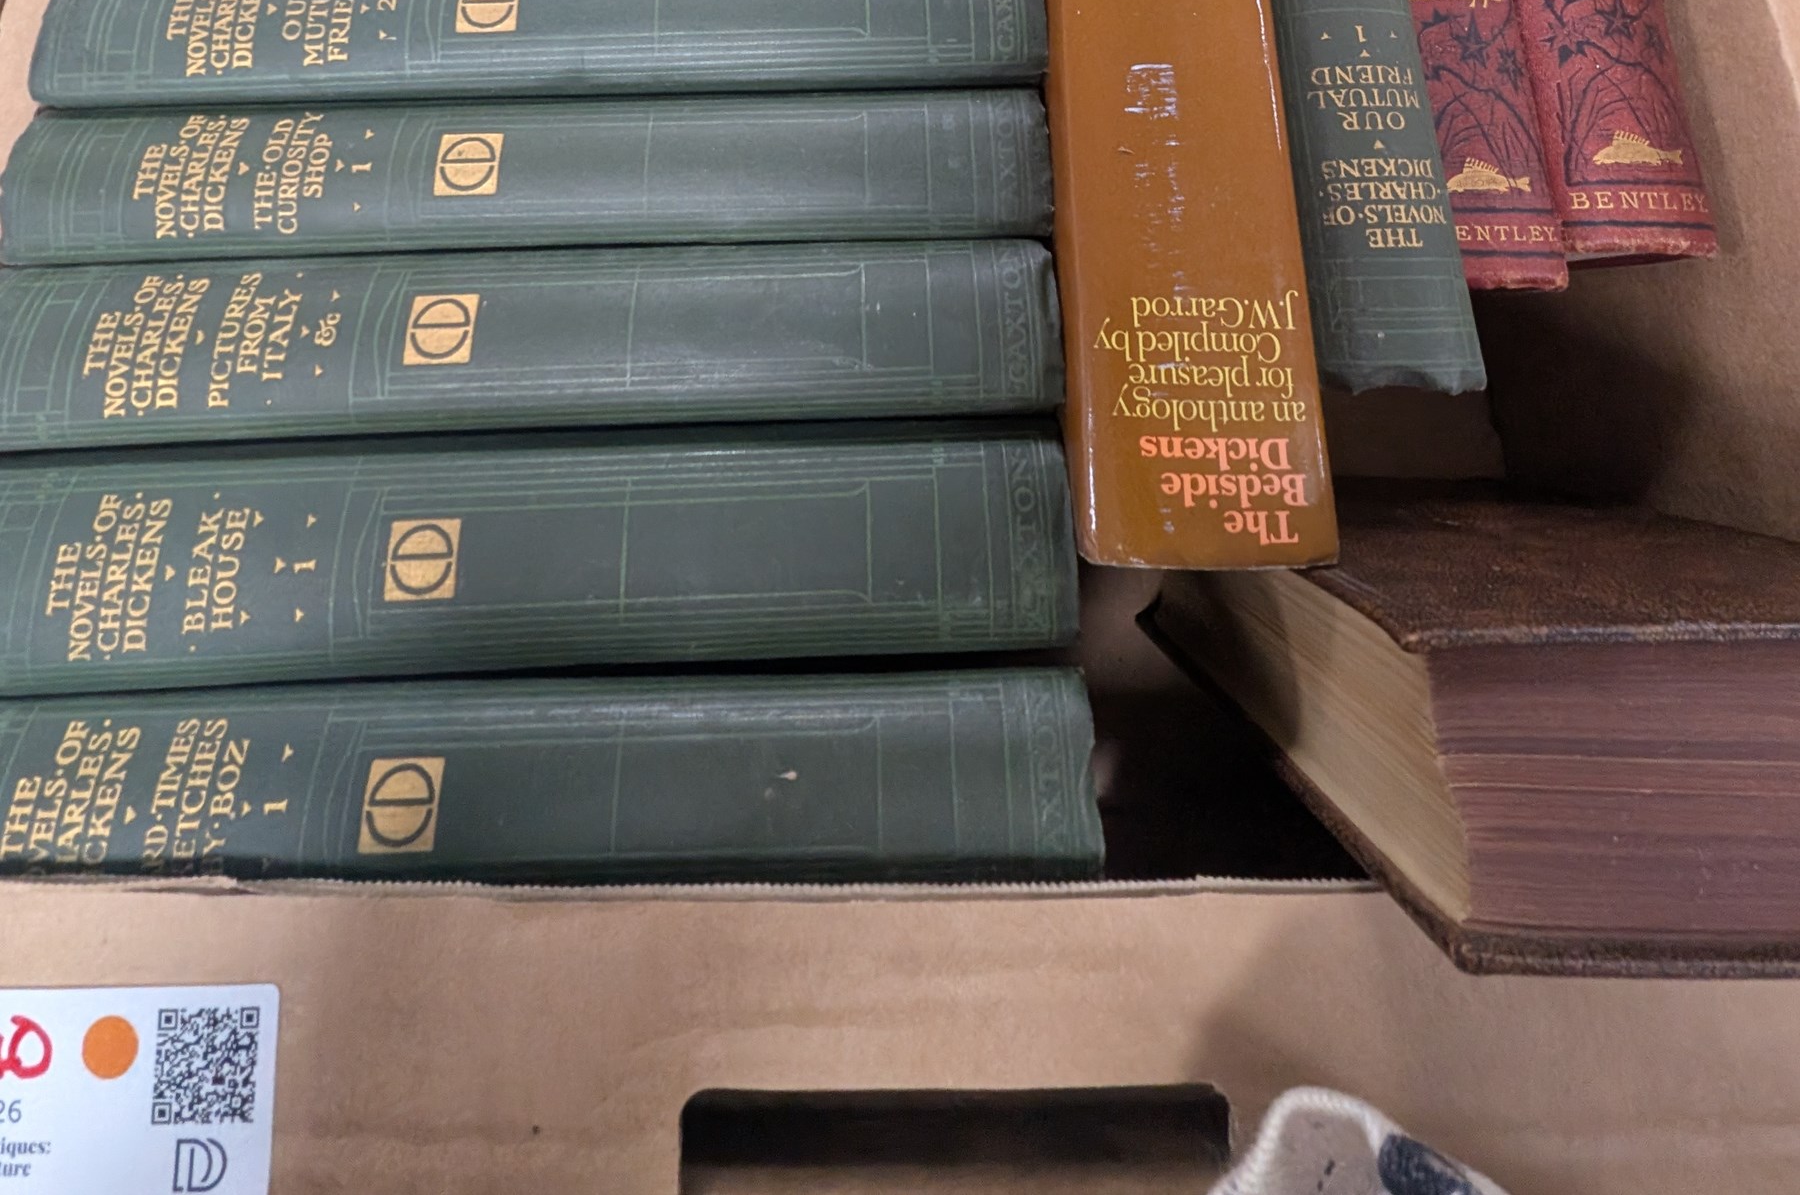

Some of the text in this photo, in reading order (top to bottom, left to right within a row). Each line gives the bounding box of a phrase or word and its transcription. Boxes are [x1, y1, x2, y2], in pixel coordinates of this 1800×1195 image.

[1354, 24, 1368, 44] 1
[1307, 87, 1421, 110] MUTUAL
[1311, 65, 1414, 86] FRIEND
[1339, 111, 1406, 132] OUR
[132, 143, 169, 201] THE
[155, 143, 191, 240] NOVELS
[180, 119, 227, 233] CHARLES
[203, 117, 250, 232] DICKENS
[253, 118, 295, 230] THE OLD
[277, 111, 325, 235] CURIOSITY
[302, 133, 334, 199] SHOP
[351, 162, 373, 173] 1
[1319, 158, 1435, 180] DICKENS
[1327, 180, 1436, 201] CHARLES
[1322, 204, 1448, 226] NOVELS OF
[1455, 224, 1558, 243] ENTLEY
[1569, 191, 1710, 214] BENTLEY
[1365, 227, 1424, 249] THE
[82, 310, 122, 379] THE
[103, 275, 164, 420] NOVELS OF
[130, 280, 186, 410] CHARLES
[154, 277, 211, 410] DICKENS
[208, 272, 263, 410] PICTURES
[235, 295, 277, 374] FROM
[262, 288, 303, 382] ITALY
[314, 312, 342, 348] &c
[1093, 316, 1282, 364] Compiled by
[1112, 383, 1306, 432] an anthology
[1129, 355, 1294, 399] for pleasure
[1140, 435, 1292, 471] Dickens
[1160, 471, 1309, 509] Bedside
[1223, 510, 1299, 546] The
[44, 541, 82, 616] THE
[67, 493, 124, 662] NOVELS OF
[96, 504, 146, 652] CHARLES
[122, 498, 174, 653] DICKENS
[181, 507, 226, 636] BLEAK
[210, 507, 252, 632] HOUSE
[293, 558, 317, 574] 1
[54, 720, 91, 766] OF
[151, 718, 201, 816] TIMES
[209, 737, 250, 818] BOZ
[264, 798, 289, 816] 1
[0, 775, 42, 860] THE
